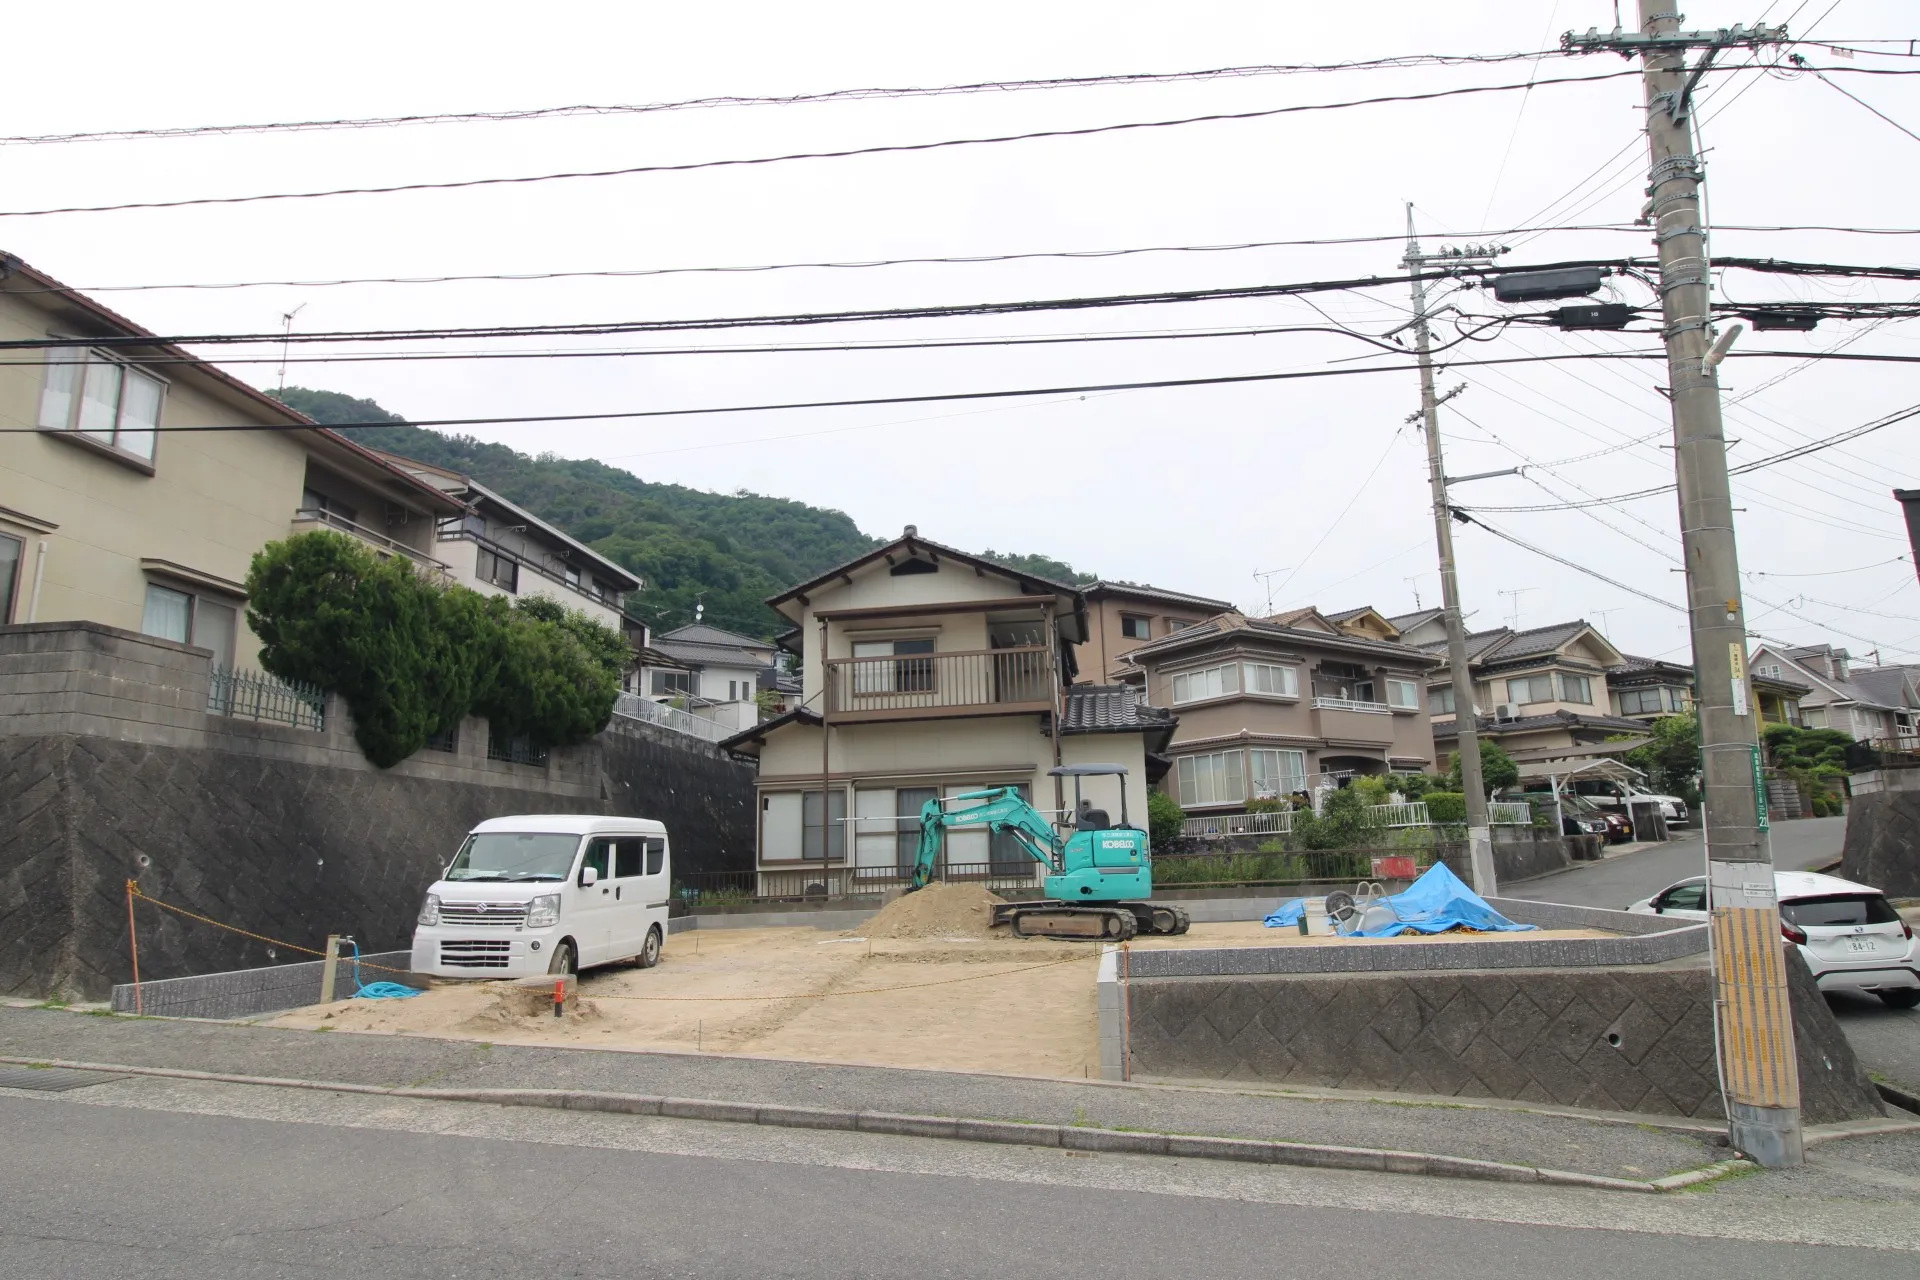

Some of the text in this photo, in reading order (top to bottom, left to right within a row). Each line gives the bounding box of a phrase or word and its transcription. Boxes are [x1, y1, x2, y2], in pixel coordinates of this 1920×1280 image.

[955, 813, 979, 823] KOBELCO
[1759, 817, 1768, 827] 21
[1102, 840, 1135, 849] KOBELCO
[1852, 941, 1876, 951] 84-12
